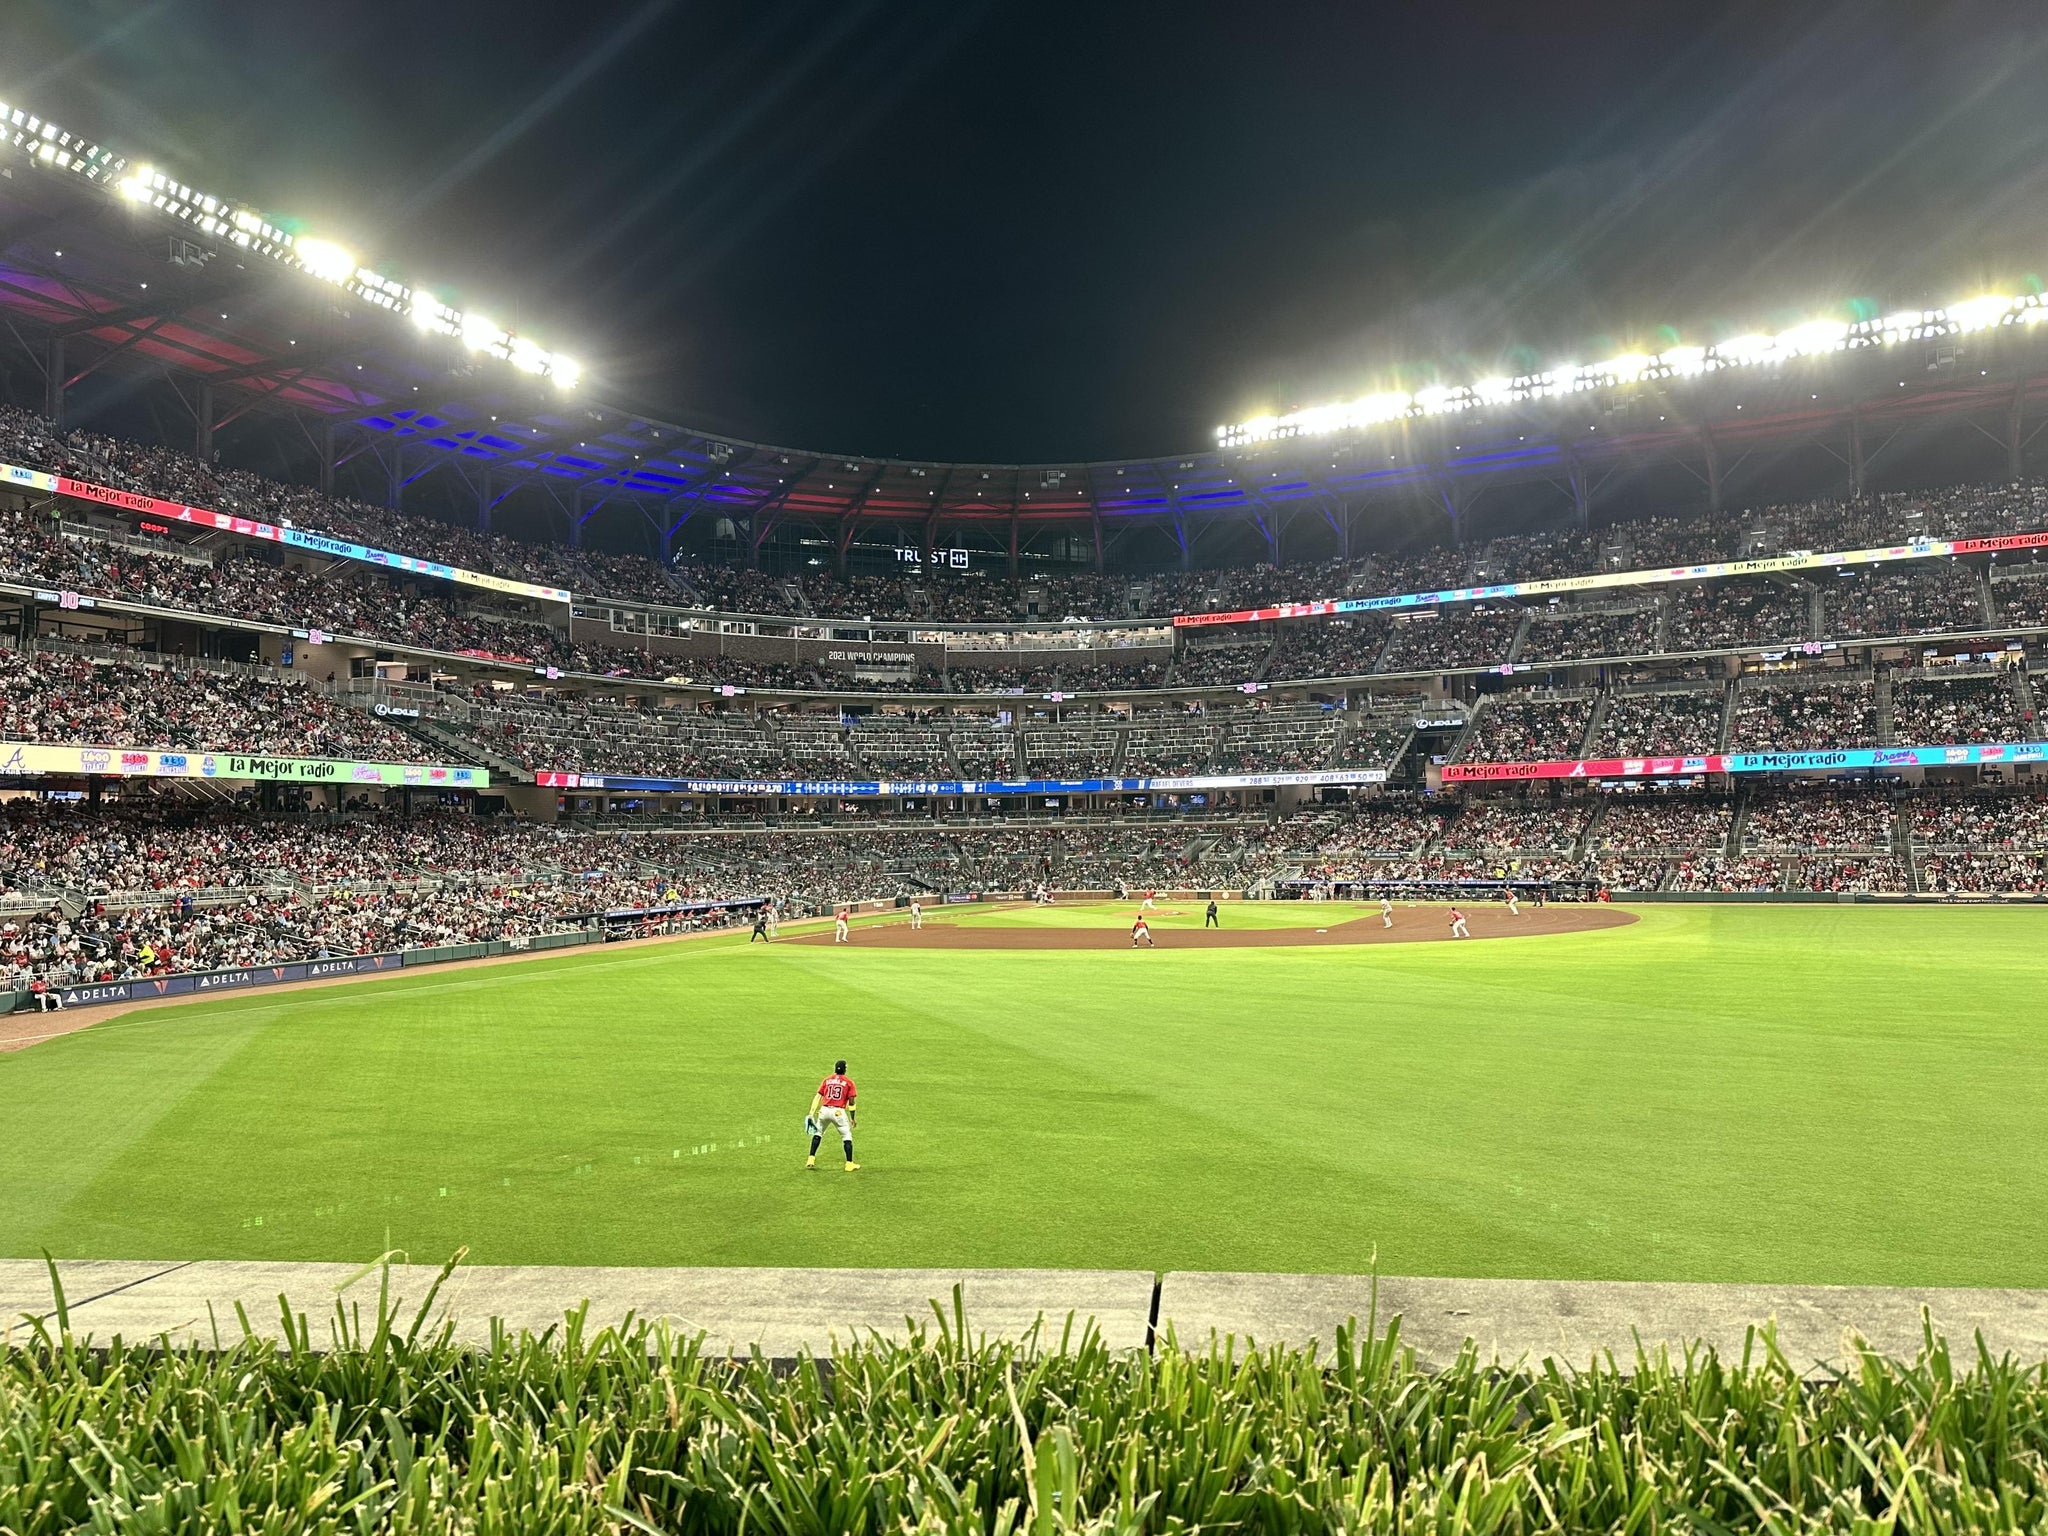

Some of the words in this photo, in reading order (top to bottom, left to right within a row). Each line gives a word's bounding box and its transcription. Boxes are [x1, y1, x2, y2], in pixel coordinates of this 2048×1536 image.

[86, 485, 121, 502] Mejor
[125, 495, 153, 509] radio
[140, 521, 169, 534] COOP'S
[304, 534, 330, 549] Mejor
[330, 543, 352, 554] radio
[1979, 538, 2015, 549] Mejor
[2018, 535, 2048, 545] radio
[894, 548, 947, 563] TRUST
[59, 590, 79, 610] 10
[1355, 600, 1379, 609] Mejor
[1380, 597, 1402, 606] radio
[1802, 641, 1822, 654] 44
[829, 651, 846, 660] 2021
[847, 651, 872, 661] WORLD
[873, 652, 915, 662] CHAMPIONS
[387, 706, 419, 717] LEXUS
[1428, 719, 1463, 727] LEXUS
[121, 753, 149, 765] 1460
[159, 754, 187, 766] 1130
[1744, 756, 1758, 767] La
[1762, 754, 1807, 768] Mejor
[1808, 753, 1846, 765] radio
[1872, 750, 1911, 765] Braves
[229, 757, 245, 772] La
[250, 759, 294, 778] Mejor
[300, 763, 335, 778] radio
[1448, 767, 1459, 778] La
[1463, 765, 1501, 779] Mejor
[1505, 764, 1538, 776] radio
[323, 962, 354, 972] DELTA
[213, 972, 250, 984] DELTA
[82, 986, 126, 1000] DELTA
[826, 1084, 843, 1100] 13
